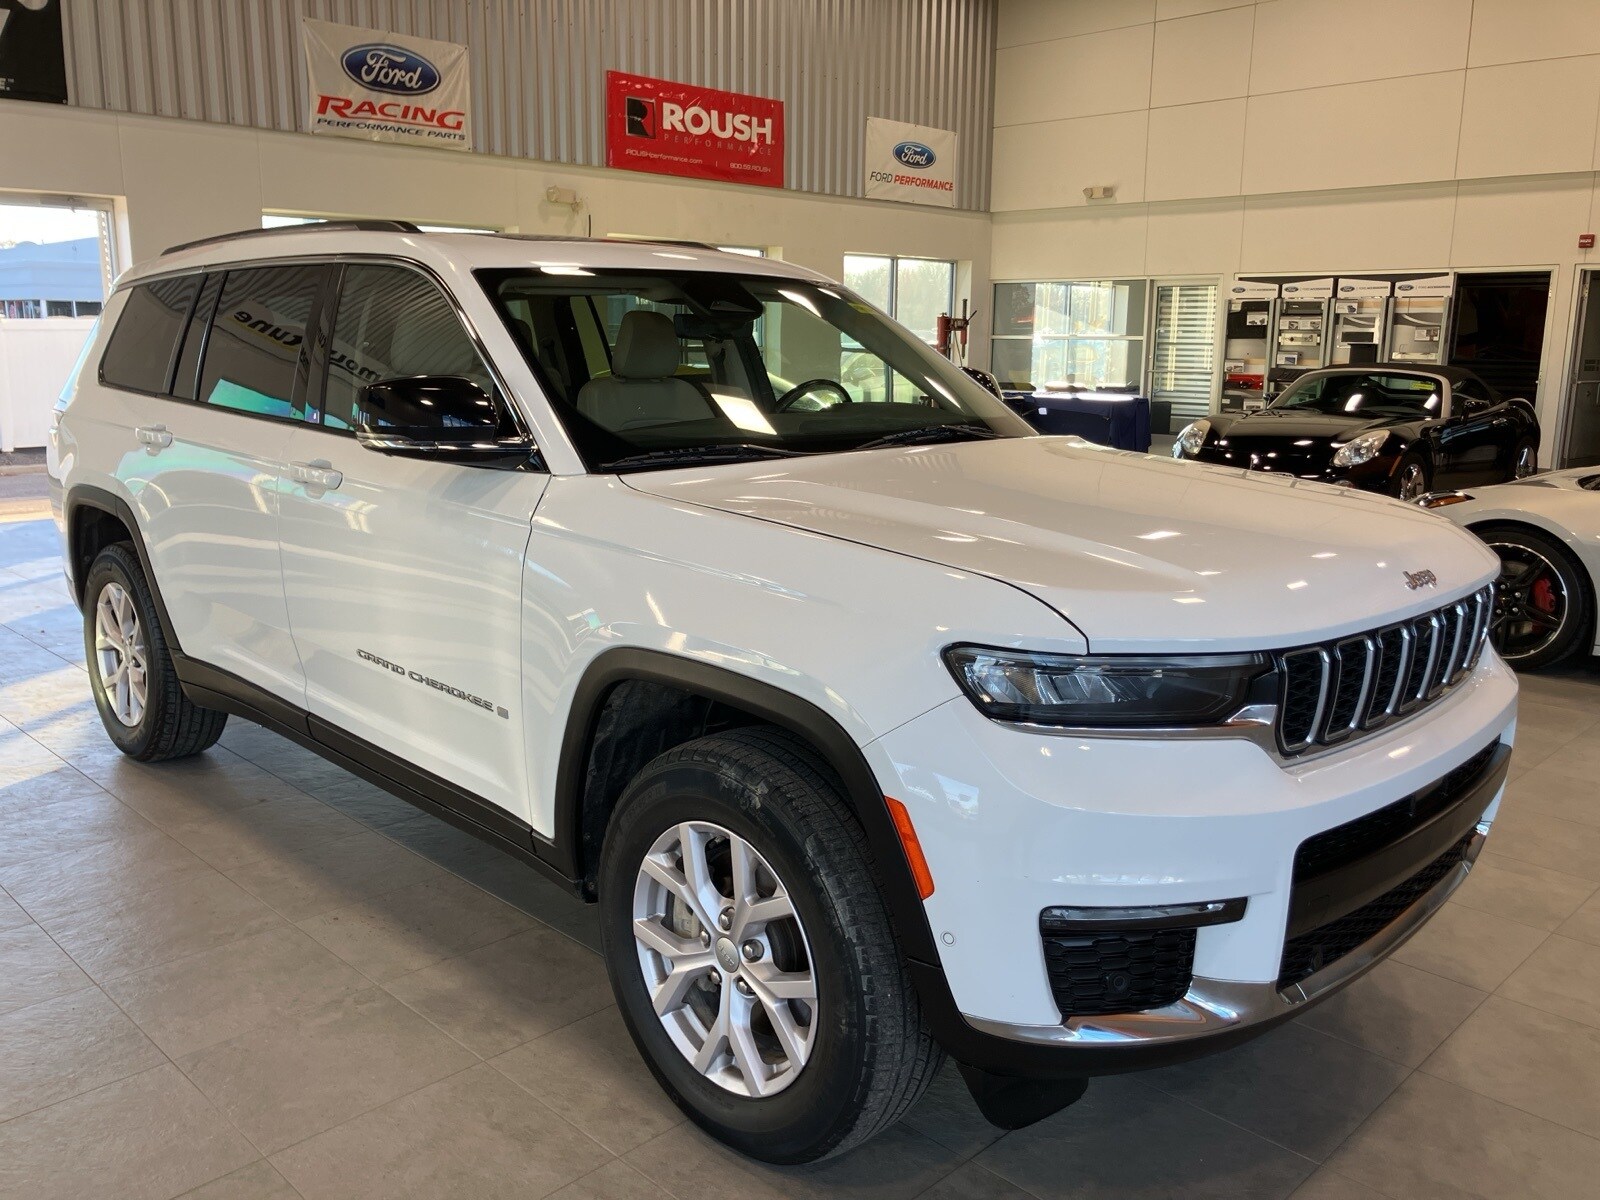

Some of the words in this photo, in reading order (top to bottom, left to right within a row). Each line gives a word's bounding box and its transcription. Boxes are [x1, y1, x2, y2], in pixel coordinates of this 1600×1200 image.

[361, 50, 422, 89] Ford
[317, 94, 465, 131] RACING
[662, 102, 773, 145] ROUSH
[317, 117, 423, 137] PERFORMANCE
[427, 130, 466, 141] PARTS
[901, 145, 928, 165] Ford
[869, 171, 893, 183] FORD
[893, 174, 954, 192] PERFORMANCE
[1402, 569, 1437, 590] Jeep
[356, 648, 405, 676] GRAND
[408, 670, 494, 712] CHEROKEE
